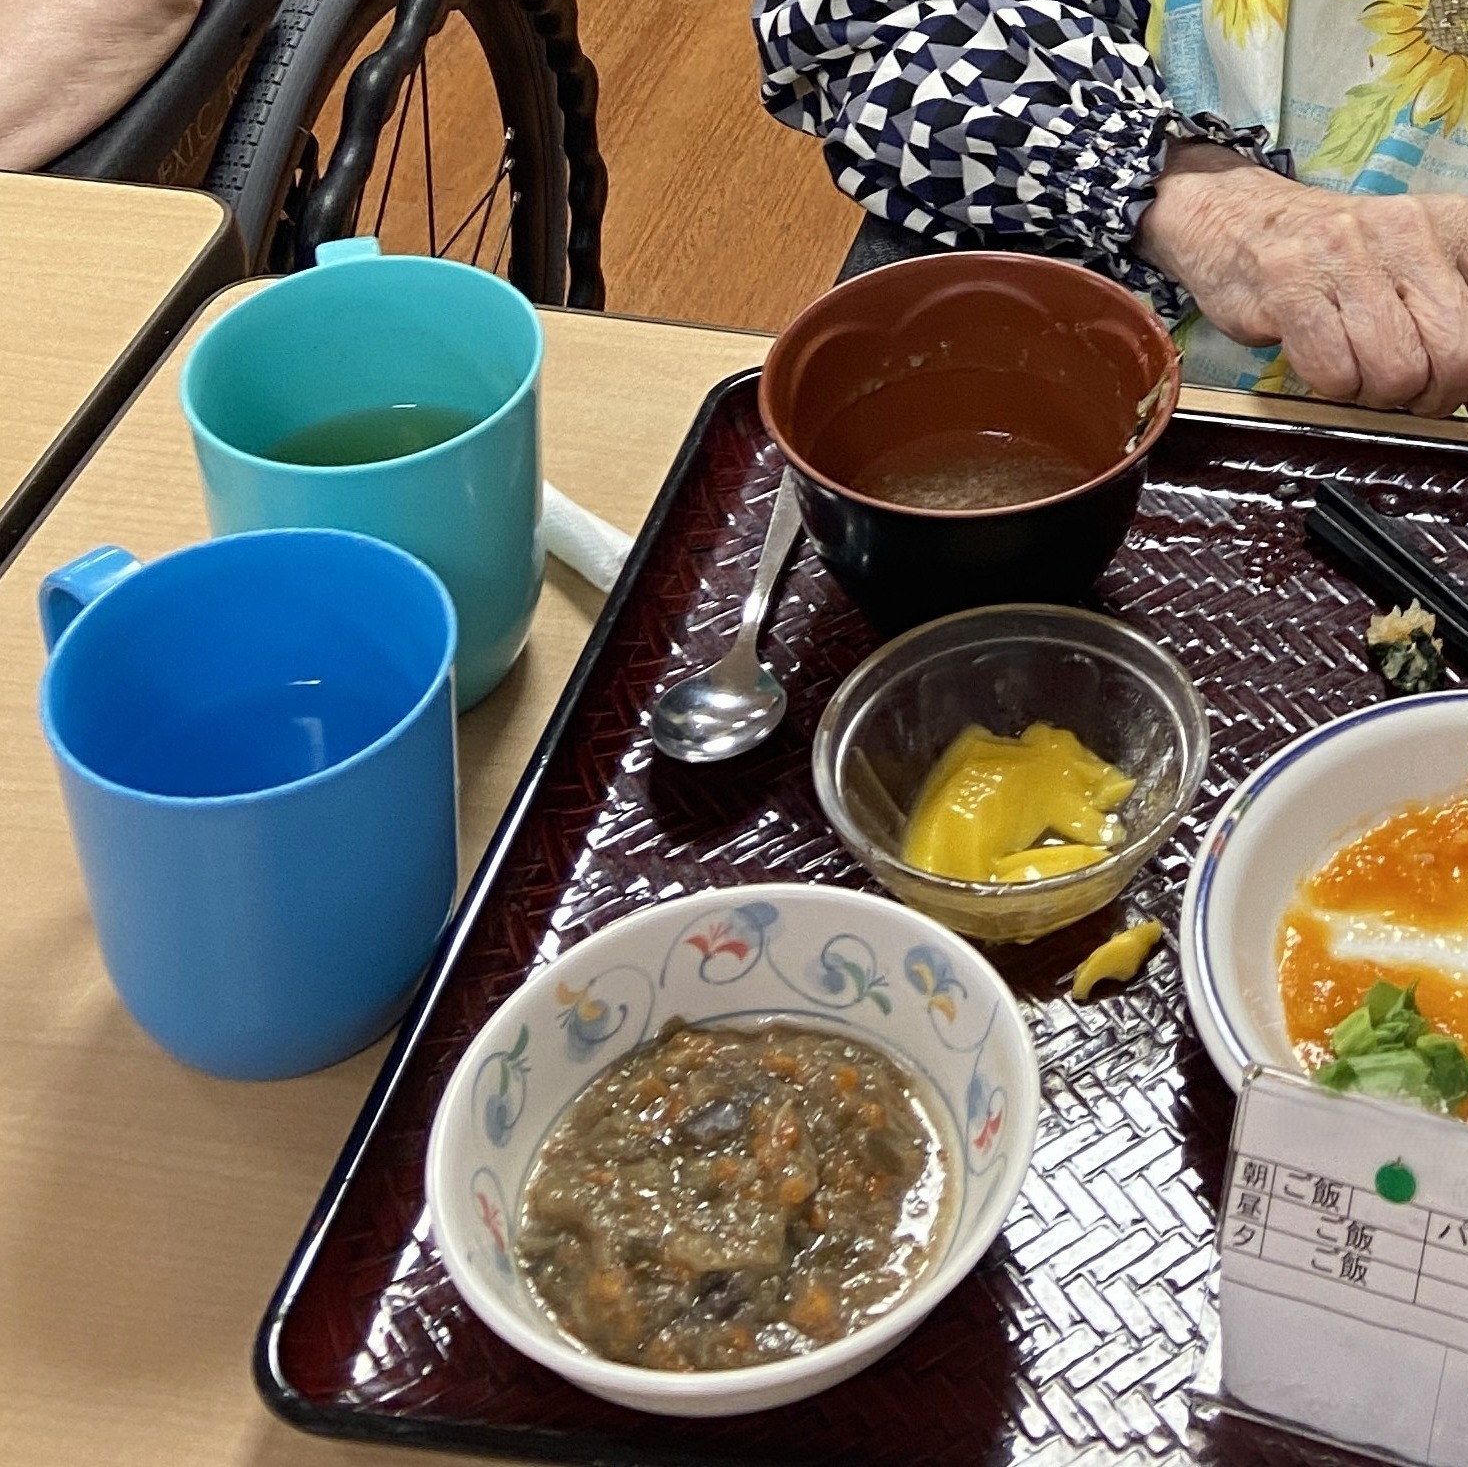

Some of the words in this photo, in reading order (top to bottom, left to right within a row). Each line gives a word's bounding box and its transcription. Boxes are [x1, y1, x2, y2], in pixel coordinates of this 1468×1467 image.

[1243, 1162, 1268, 1190] 朝
[1284, 1172, 1344, 1213] ご飯
[1237, 1192, 1262, 1219] 昼
[1316, 1215, 1374, 1255] ご飯
[1311, 1246, 1369, 1287] ご飯
